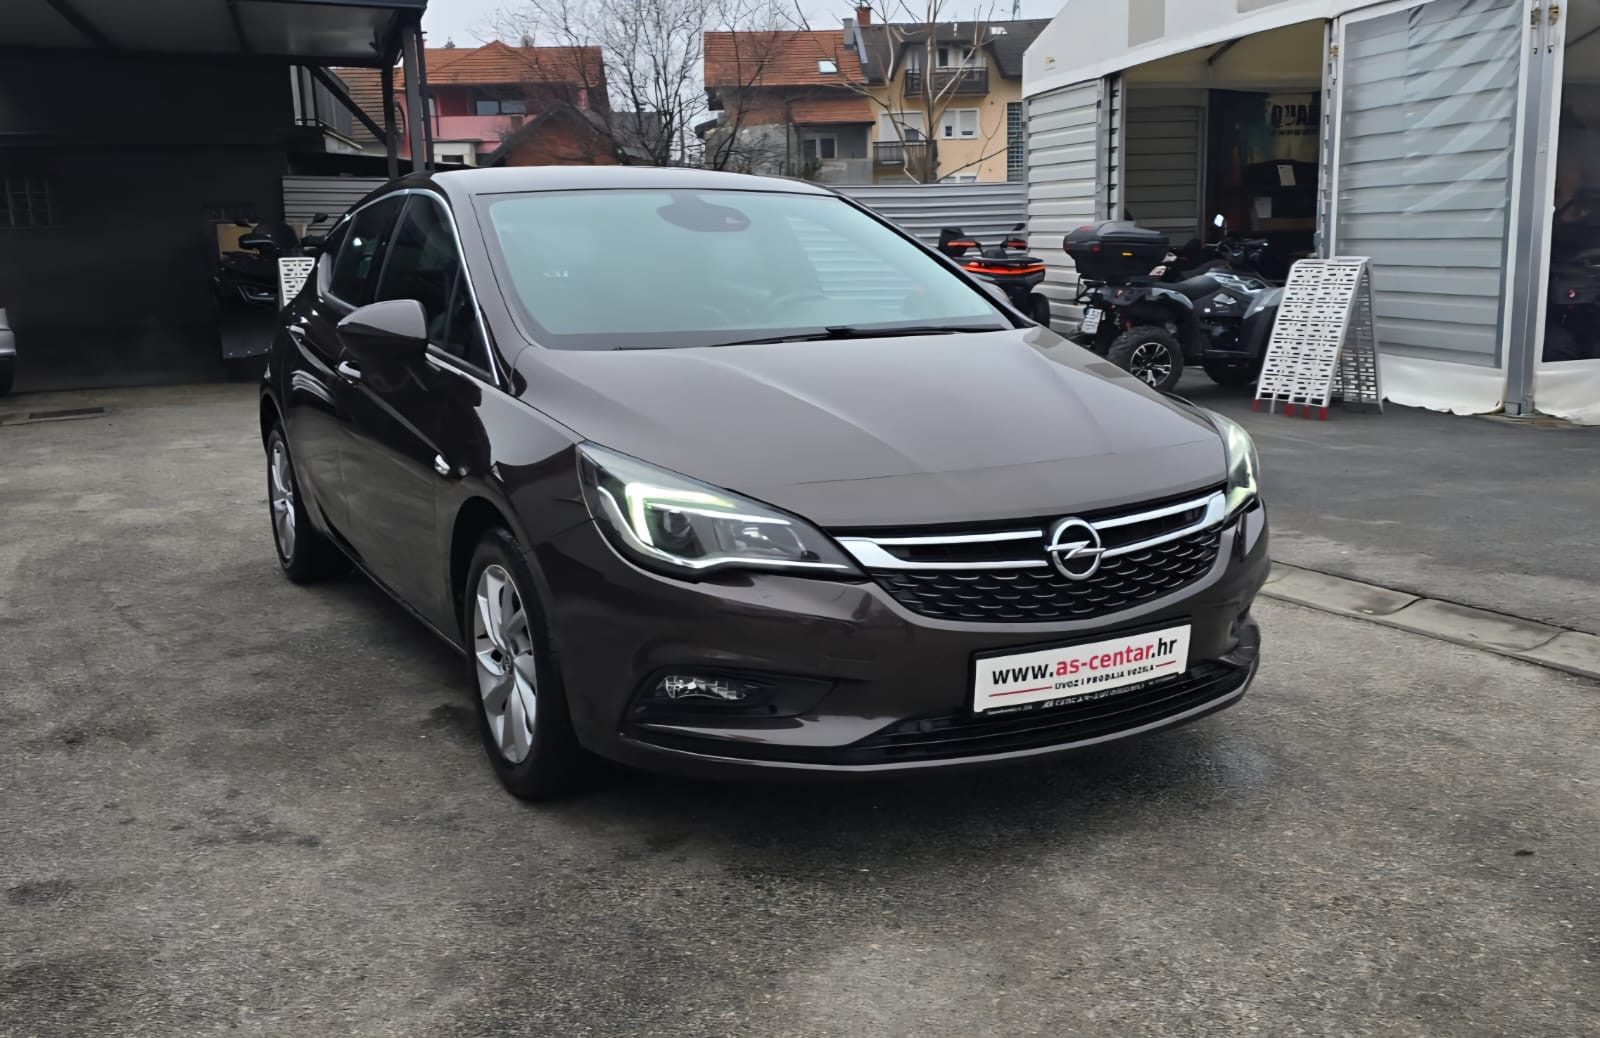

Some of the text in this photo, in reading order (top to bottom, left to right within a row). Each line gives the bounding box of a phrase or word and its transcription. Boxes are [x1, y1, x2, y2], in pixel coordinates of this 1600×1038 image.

[992, 637, 1177, 686] www.as-centar.hr
[1054, 679, 1079, 690] UVOZ
[1086, 671, 1125, 685] PRODAJA
